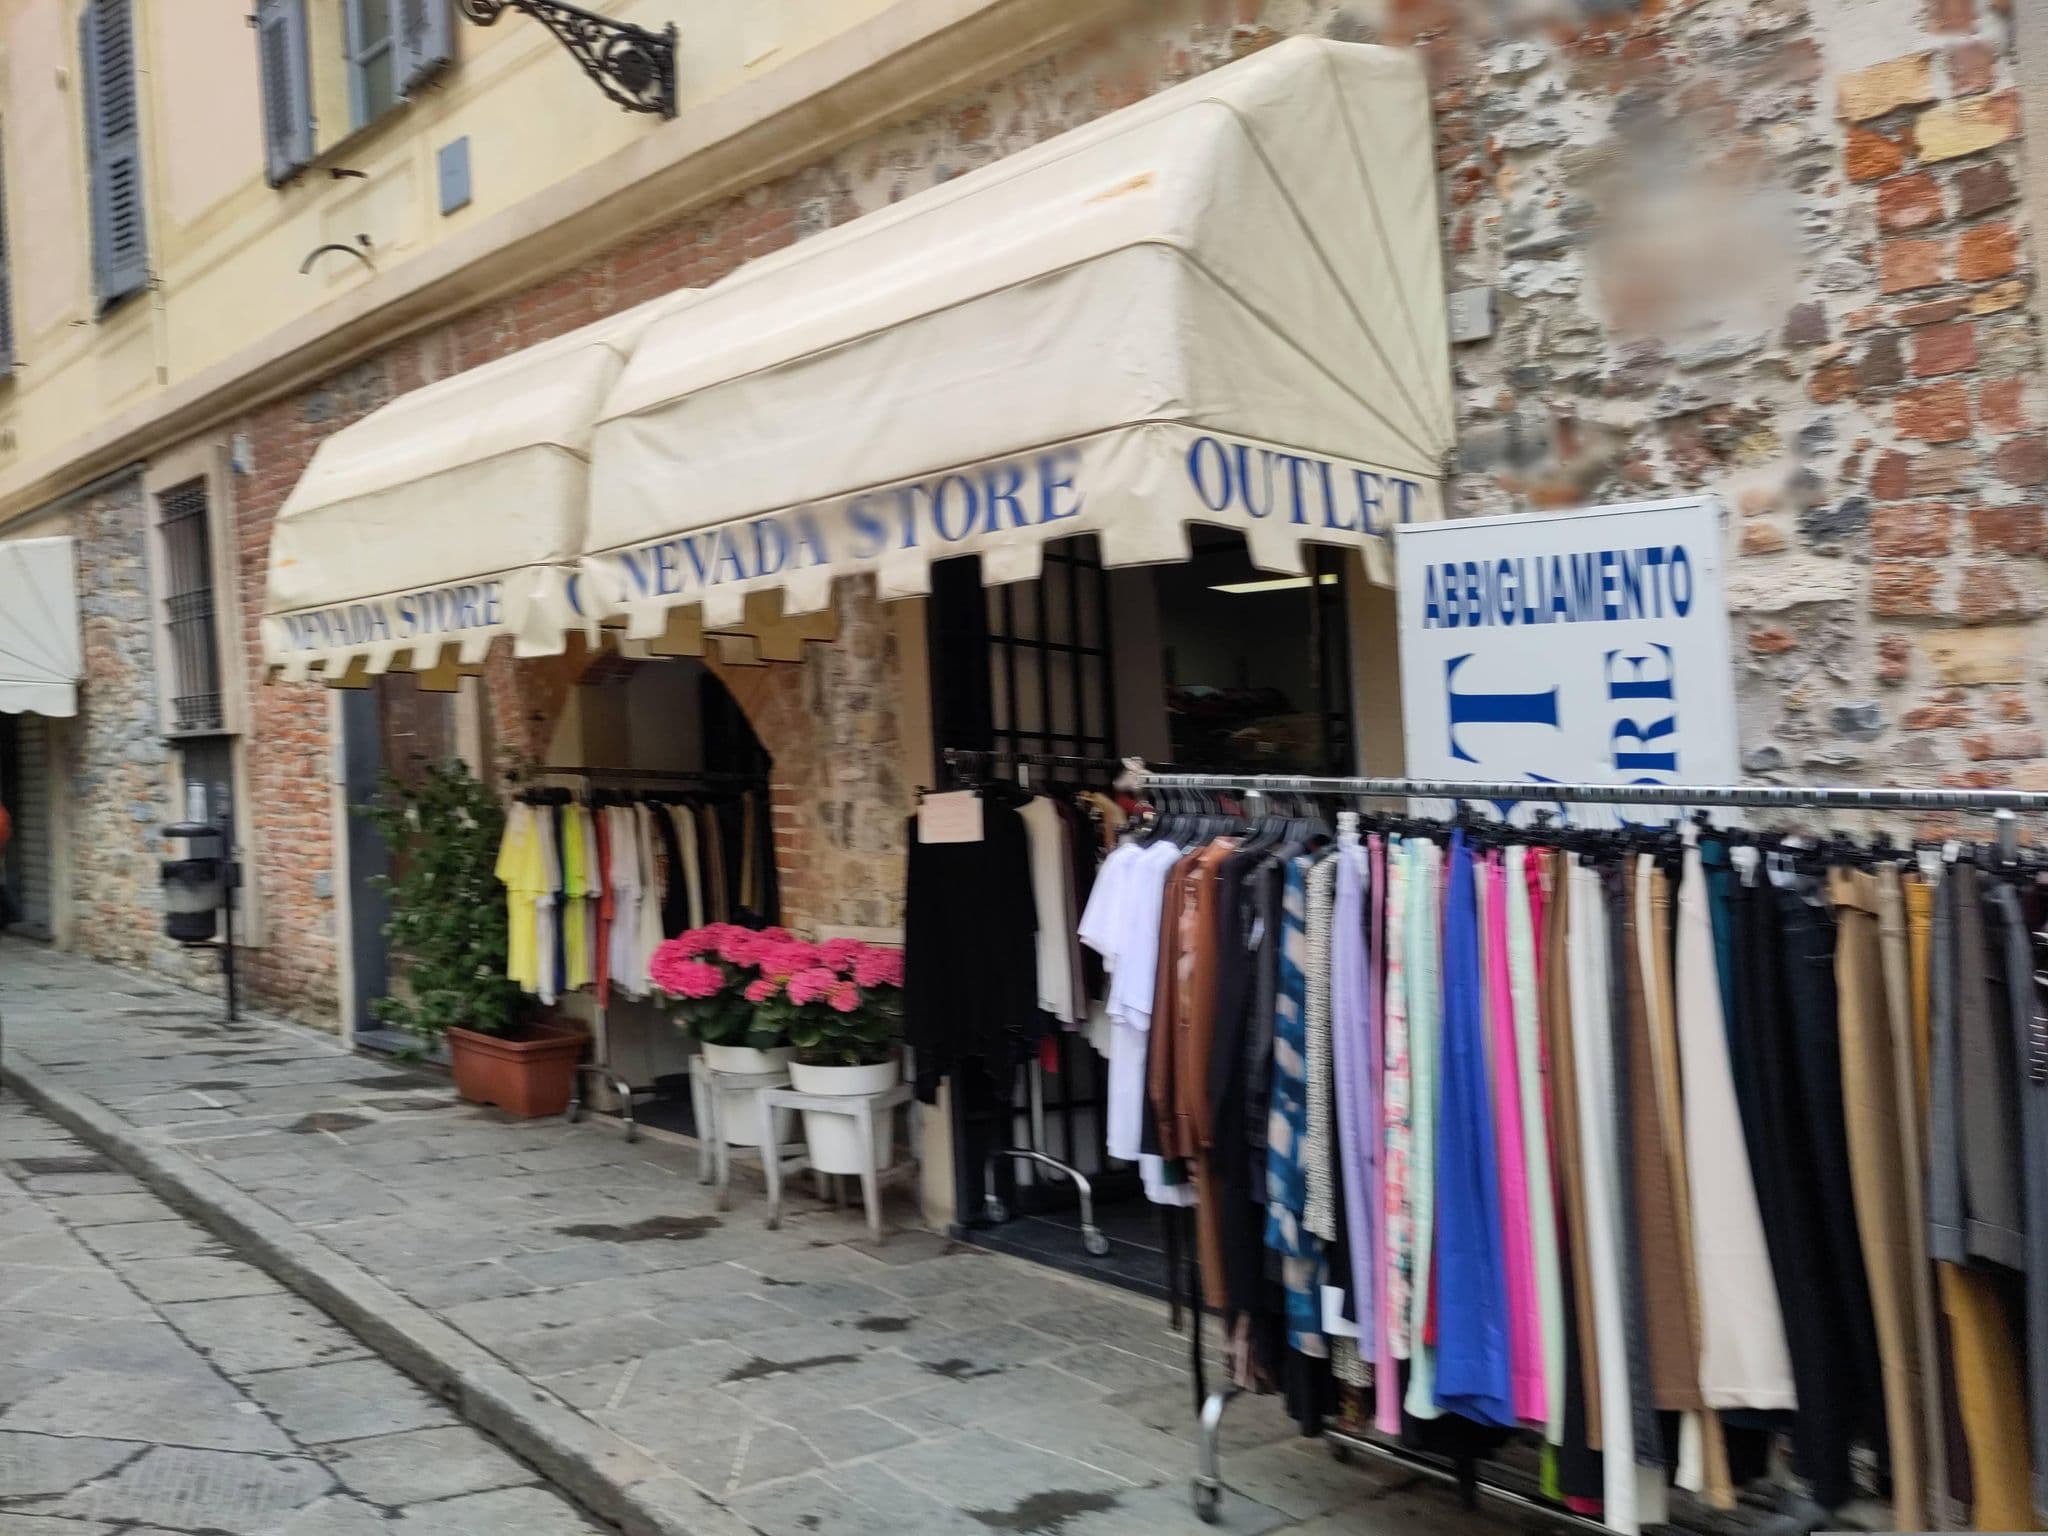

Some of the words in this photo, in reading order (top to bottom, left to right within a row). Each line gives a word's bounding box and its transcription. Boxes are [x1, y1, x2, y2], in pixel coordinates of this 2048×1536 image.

[618, 514, 829, 602] NEVADA
[845, 449, 1084, 559] STORE
[1186, 436, 1420, 537] OUTLET
[281, 603, 391, 651] NEVADA
[400, 580, 500, 638] STORE
[1422, 545, 1693, 629] ABBIGLIAMENTO
